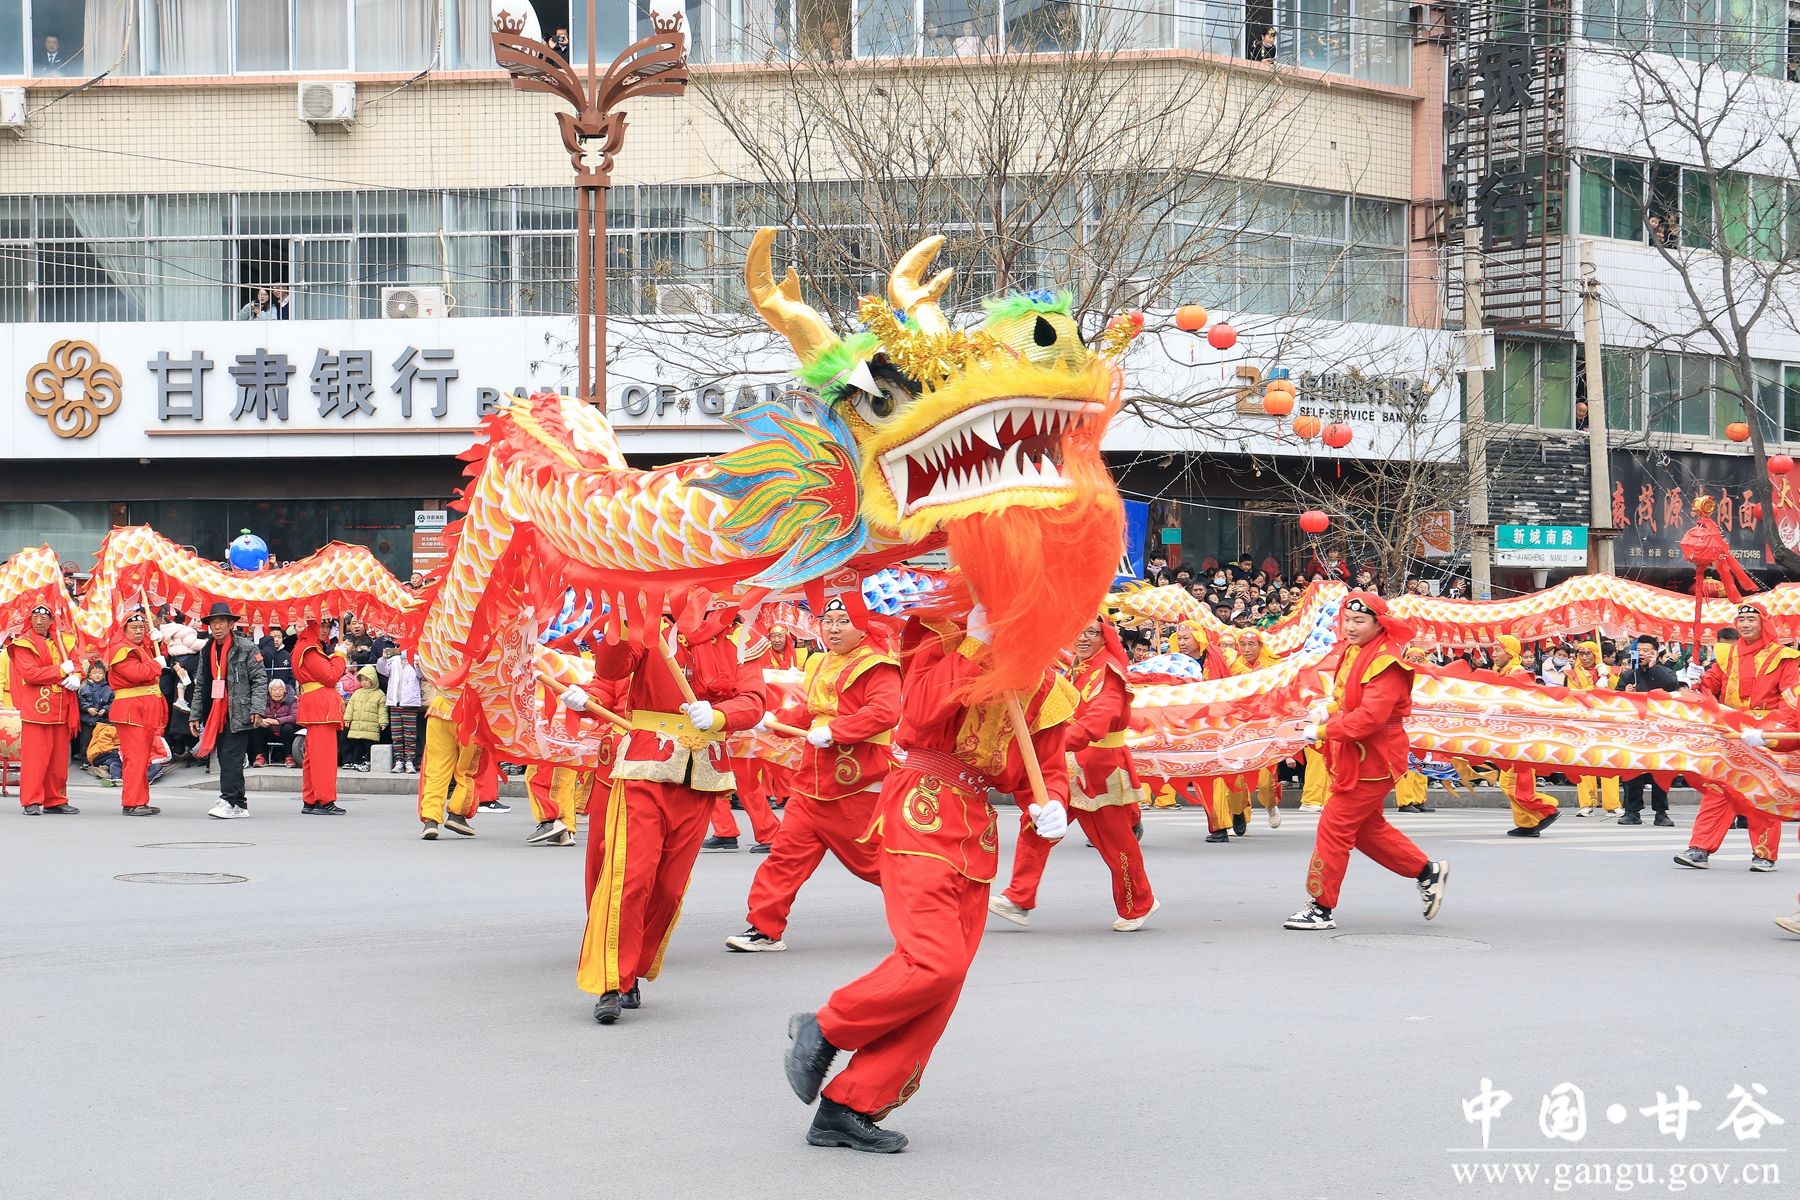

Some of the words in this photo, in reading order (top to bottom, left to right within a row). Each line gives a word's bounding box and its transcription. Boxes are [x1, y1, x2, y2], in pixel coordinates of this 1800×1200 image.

[1474, 35, 1535, 251] 银行
[147, 345, 459, 421] 甘肃银行
[621, 385, 676, 417] OF
[1513, 528, 1573, 545] 新城南路
